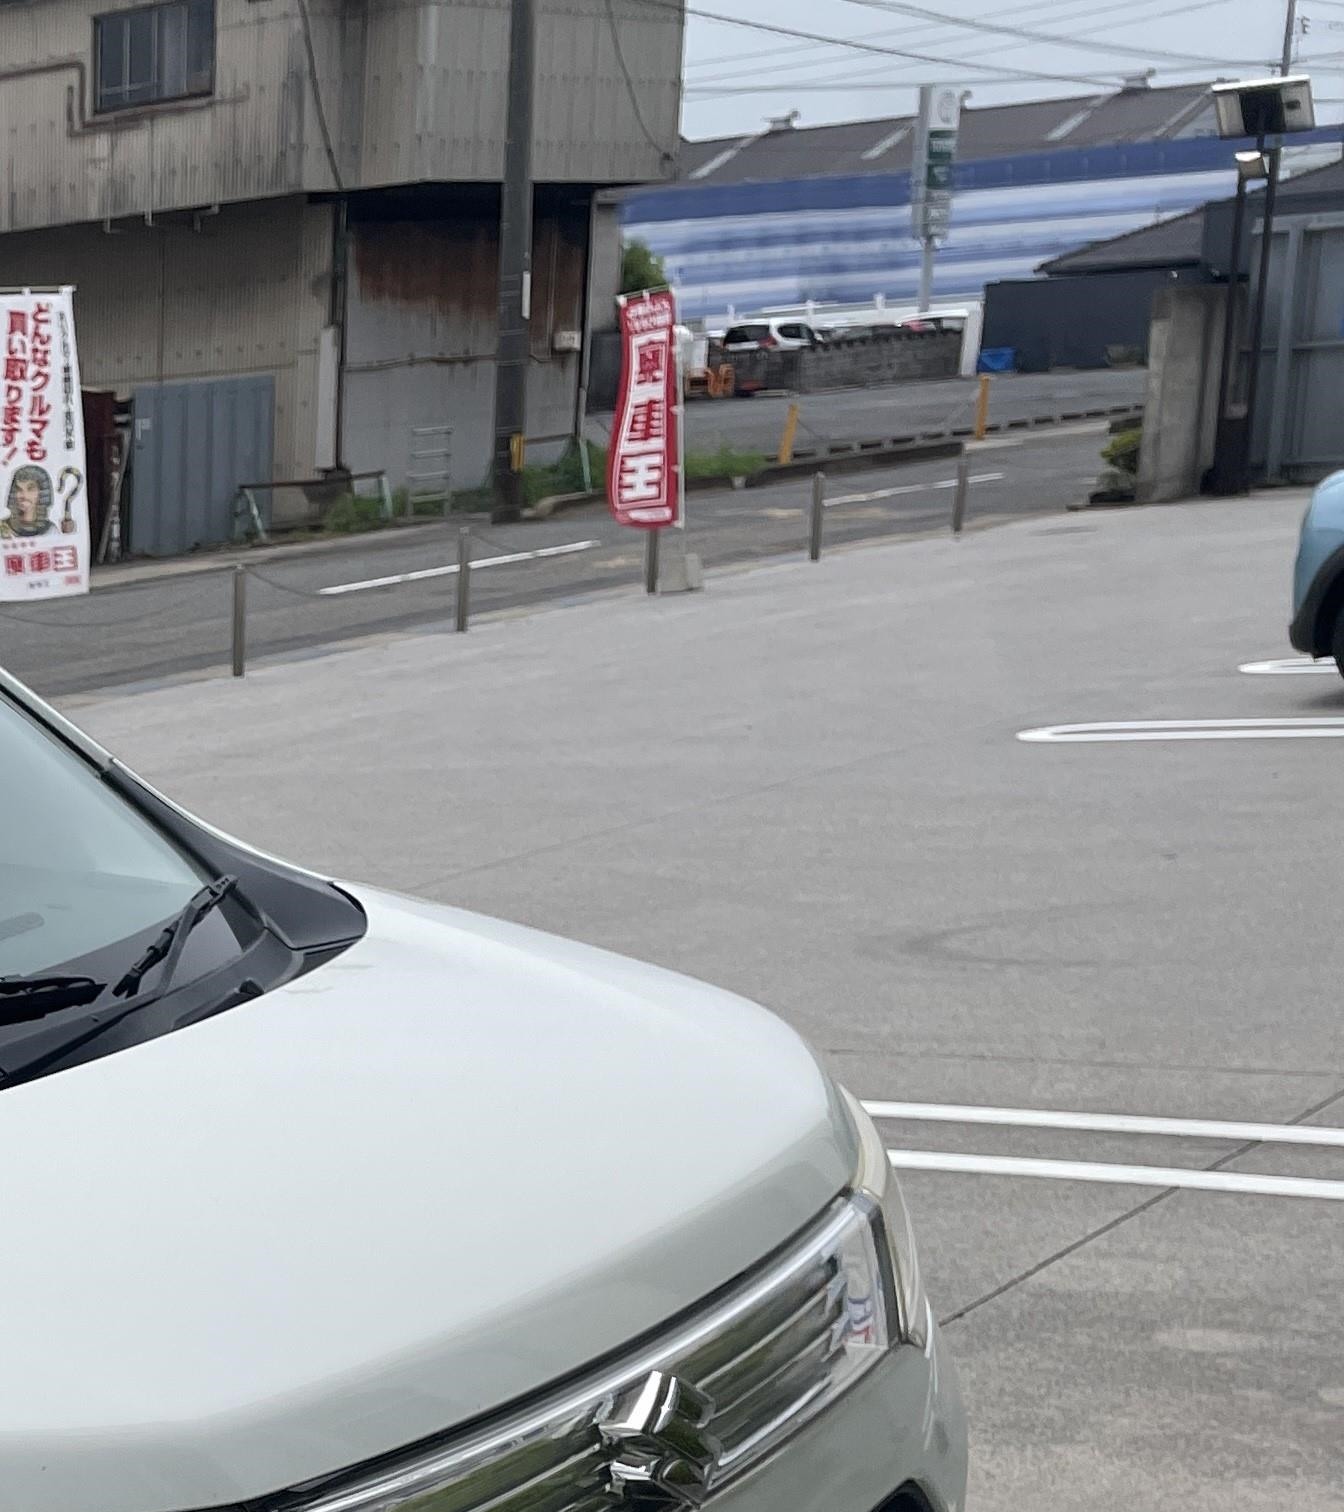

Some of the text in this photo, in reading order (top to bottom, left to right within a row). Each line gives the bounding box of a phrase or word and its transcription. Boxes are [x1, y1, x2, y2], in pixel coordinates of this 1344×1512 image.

[26, 302, 53, 461] どんなクルマも
